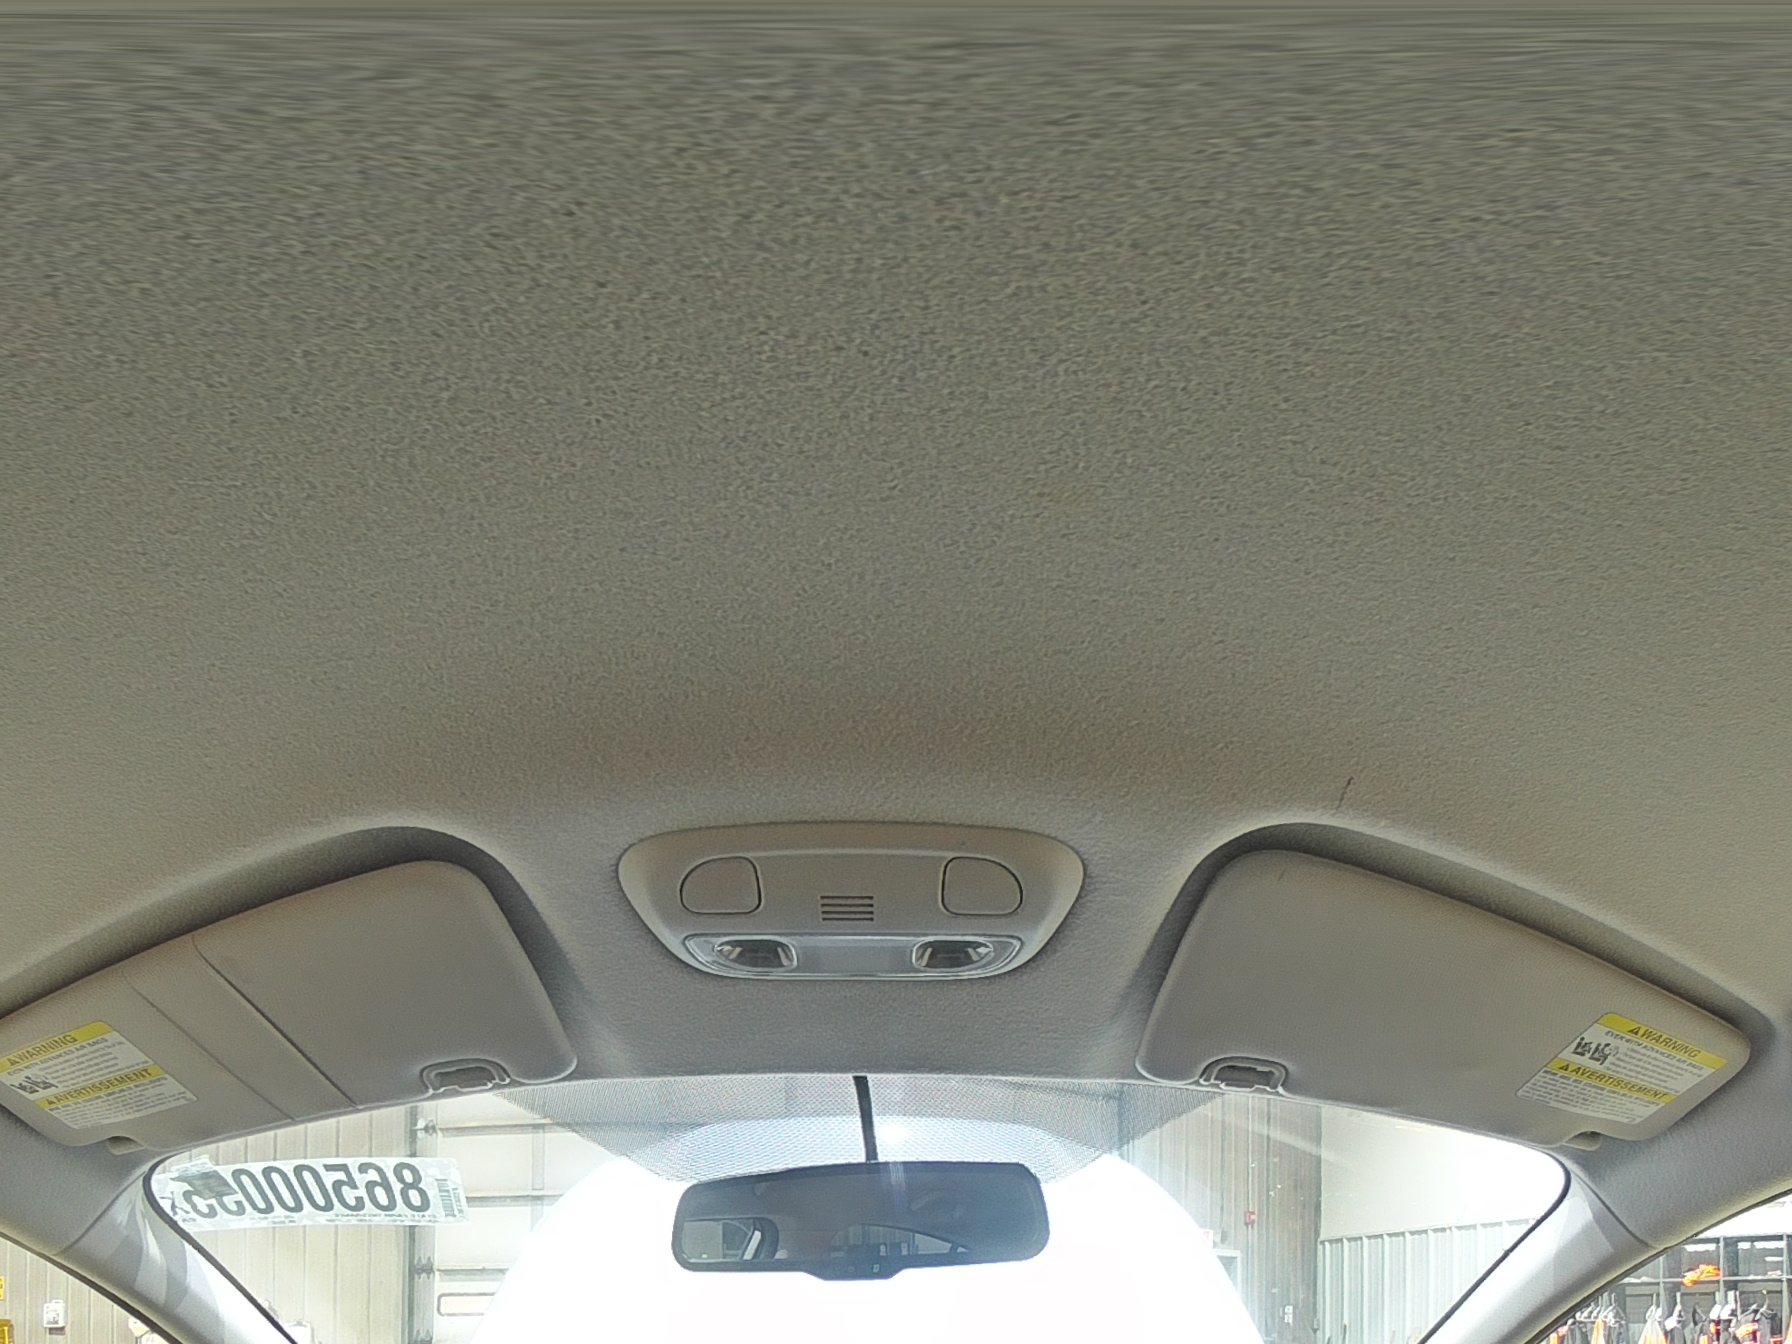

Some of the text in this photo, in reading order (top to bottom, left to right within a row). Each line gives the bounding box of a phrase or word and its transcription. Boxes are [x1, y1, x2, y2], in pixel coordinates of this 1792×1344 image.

[16, 1033, 78, 1065] WARNING
[1639, 1028, 1702, 1059] WARNING
[53, 1068, 153, 1104] AVERTISSEMENT
[1569, 1066, 1668, 1100] AVERTISSEMENT
